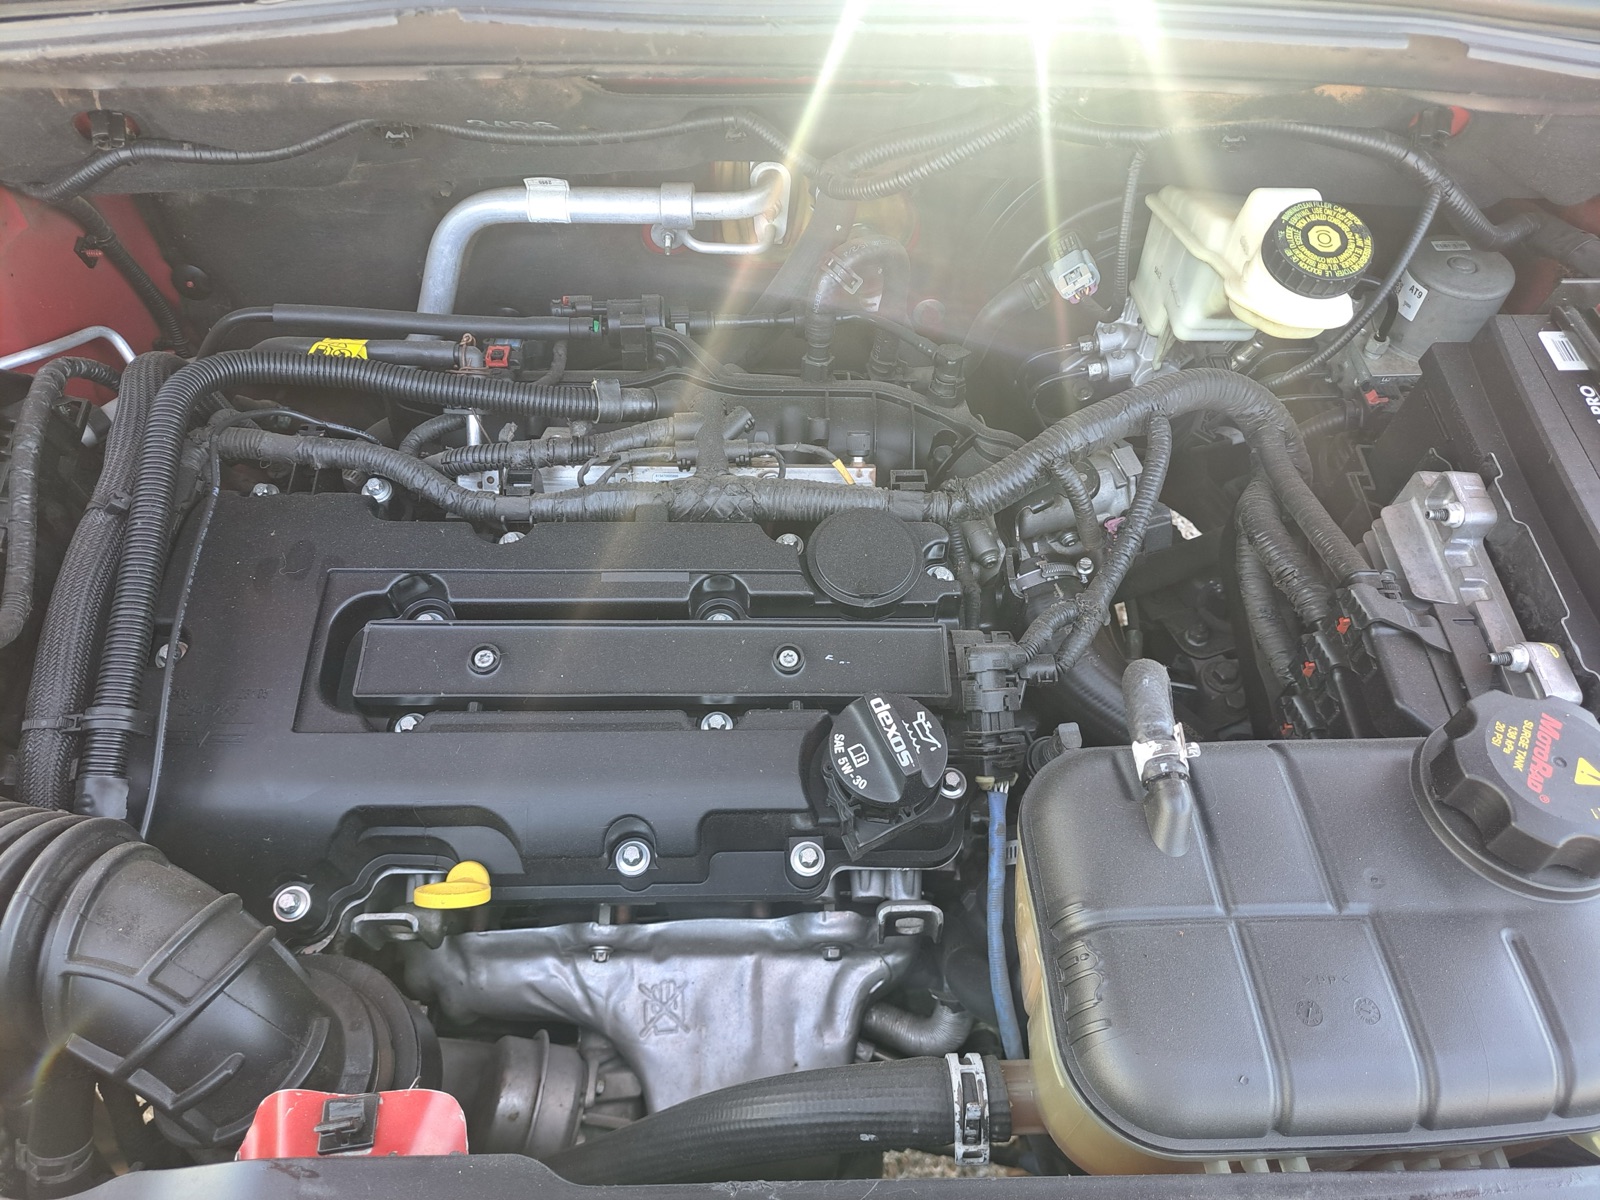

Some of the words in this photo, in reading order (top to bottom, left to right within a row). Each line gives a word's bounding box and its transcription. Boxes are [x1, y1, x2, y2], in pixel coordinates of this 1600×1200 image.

[1324, 208, 1337, 216] ONLY
[1333, 205, 1346, 213] CAP
[1408, 284, 1423, 299] AT9
[1580, 386, 1600, 414] PRO
[870, 698, 914, 767] dexos
[1494, 720, 1506, 732] 20
[1506, 726, 1518, 740] 138
[1491, 731, 1503, 747] PSI
[1518, 720, 1534, 750] SURGE
[834, 734, 845, 754] SAE
[1502, 739, 1514, 754] kPa
[1512, 750, 1528, 772] TANK
[838, 757, 868, 790] 5W-30
